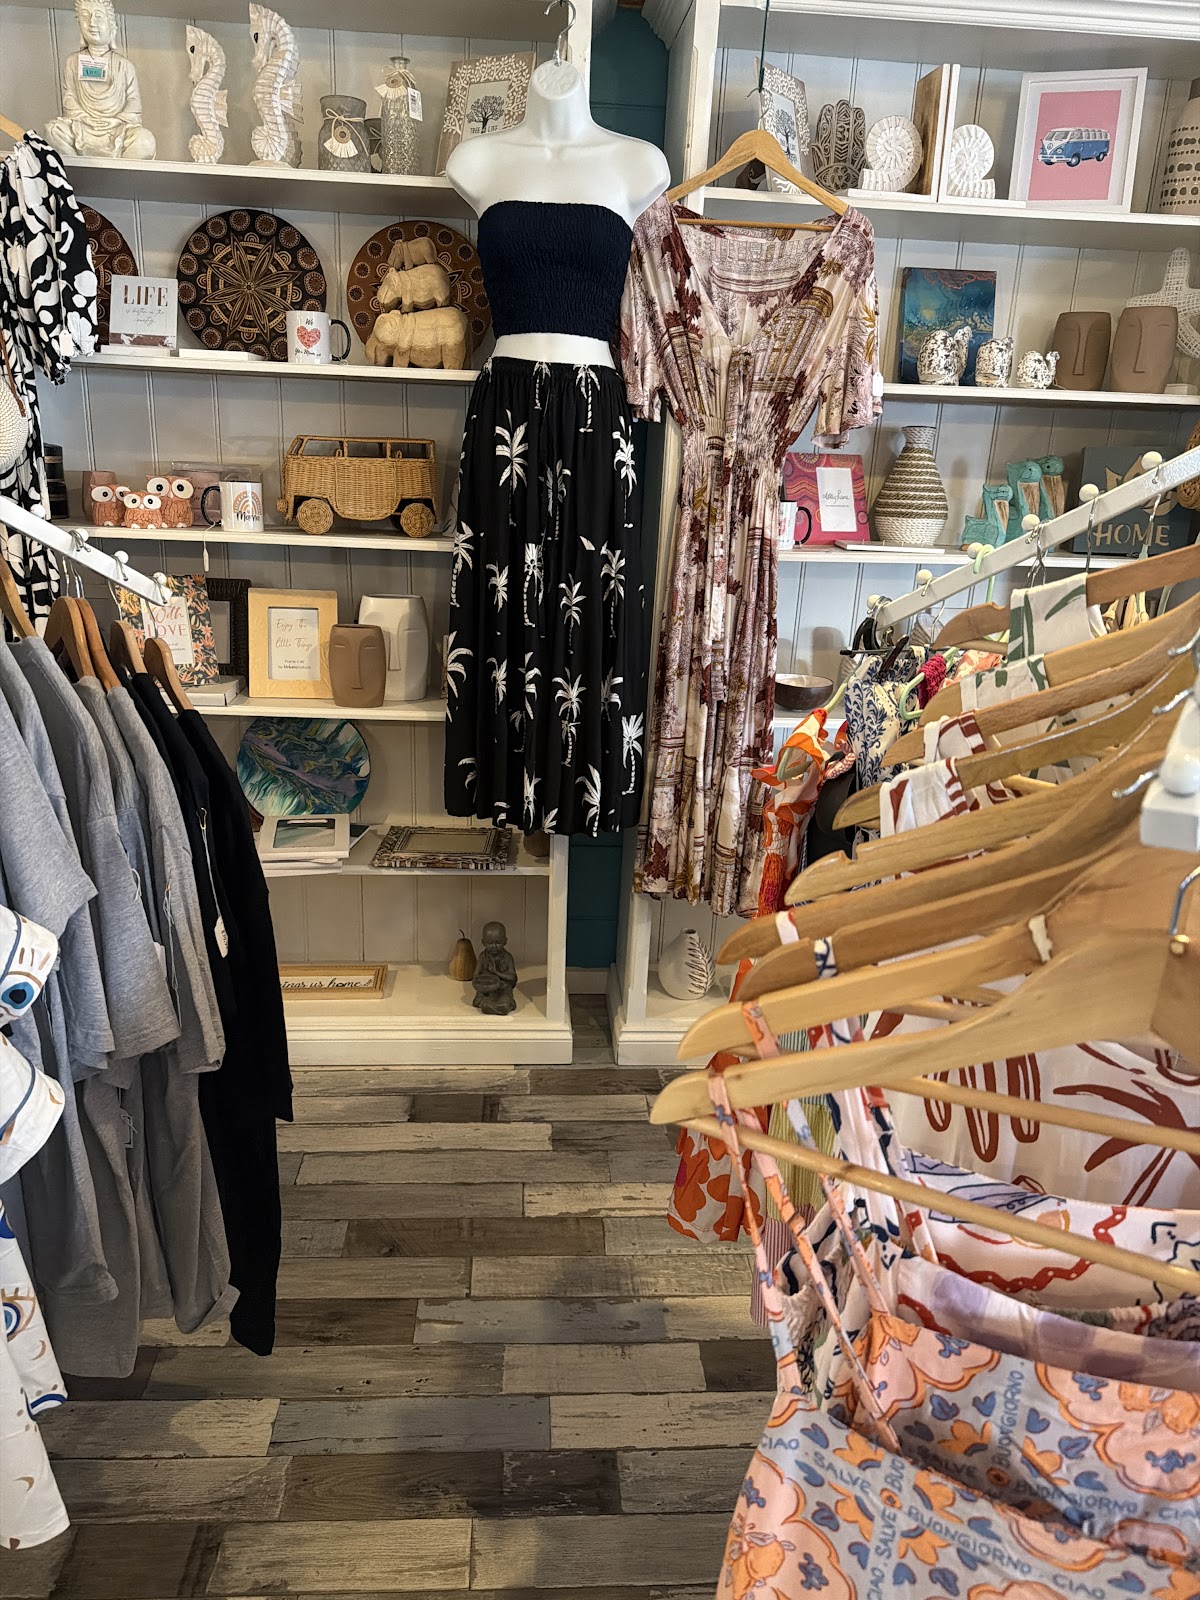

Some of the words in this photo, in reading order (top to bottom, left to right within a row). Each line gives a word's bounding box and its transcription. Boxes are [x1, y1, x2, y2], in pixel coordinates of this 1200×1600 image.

[124, 284, 168, 307] LIFE
[1092, 522, 1170, 547] HOME
[146, 624, 188, 637] LOVE
[327, 977, 362, 989] home
[991, 1369, 1025, 1470] BUONGIORNO
[760, 1433, 800, 1450] CIAO
[812, 1451, 872, 1495] SALVE
[907, 1504, 1033, 1575] BUONGIORNO
[1052, 1573, 1106, 1600] CIAO
[874, 1507, 897, 1560] SALVE
